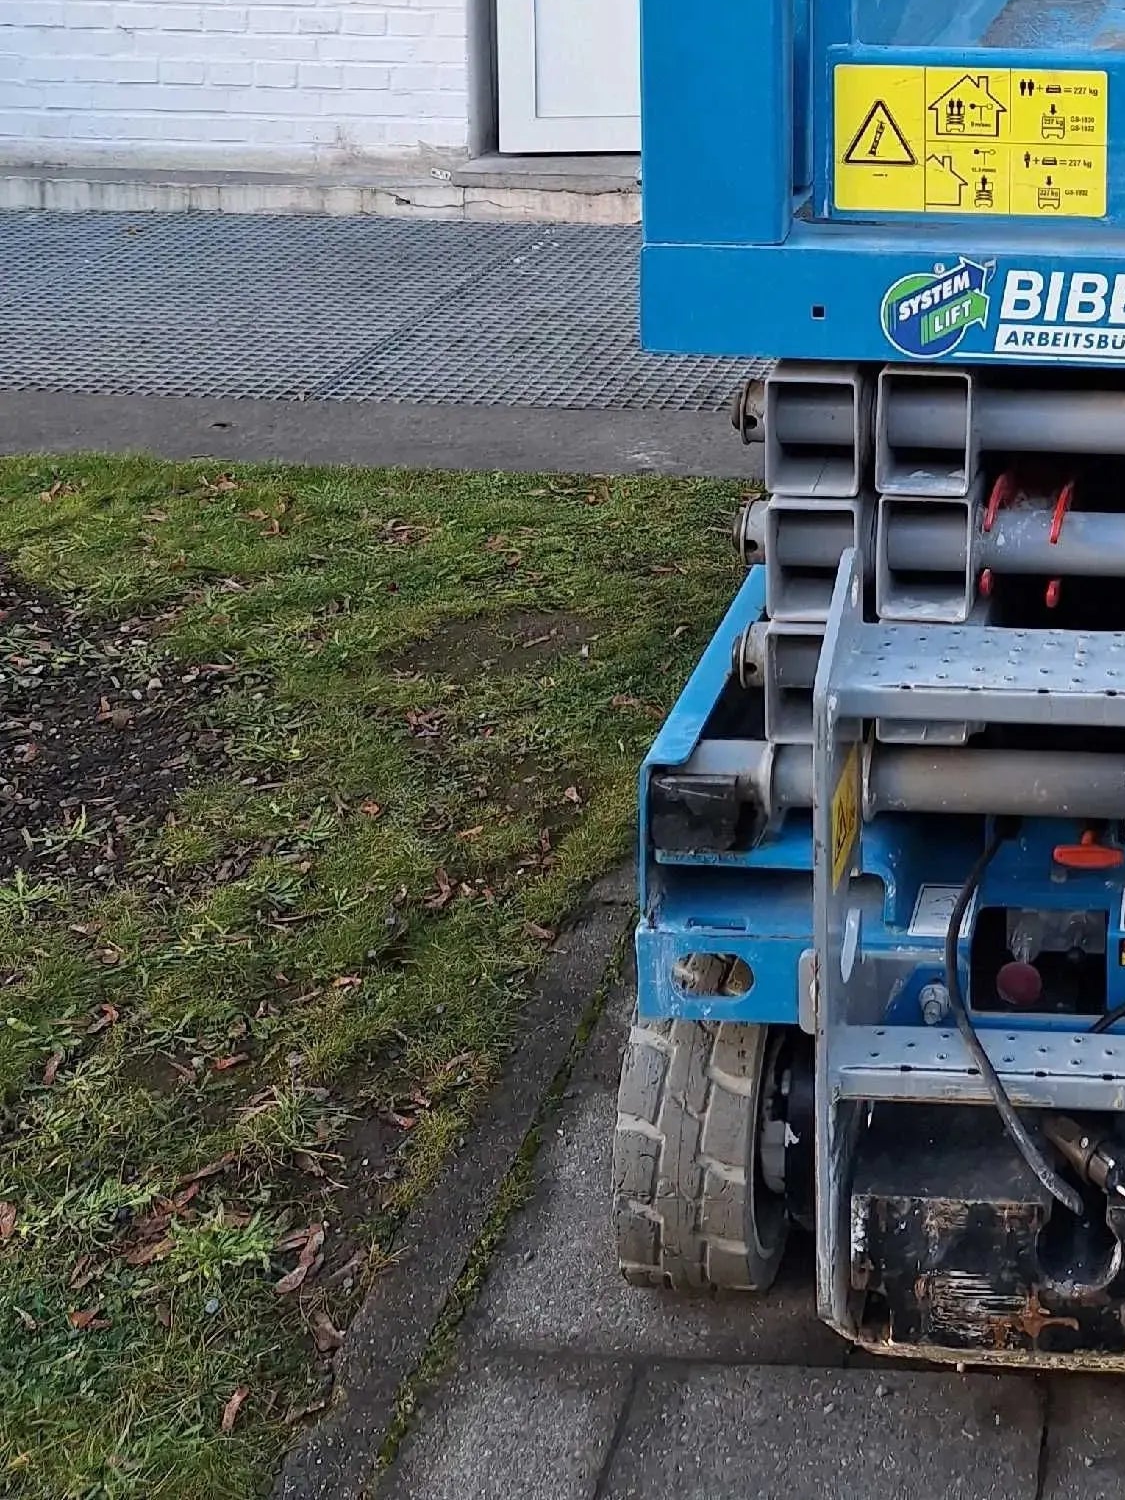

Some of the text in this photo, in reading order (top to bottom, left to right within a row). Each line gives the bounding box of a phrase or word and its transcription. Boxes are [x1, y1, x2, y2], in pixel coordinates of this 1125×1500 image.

[1073, 87, 1099, 97] 227 kg
[1068, 159, 1082, 167] 227
[898, 270, 971, 321] SYSTEM
[933, 298, 972, 333] LIFT
